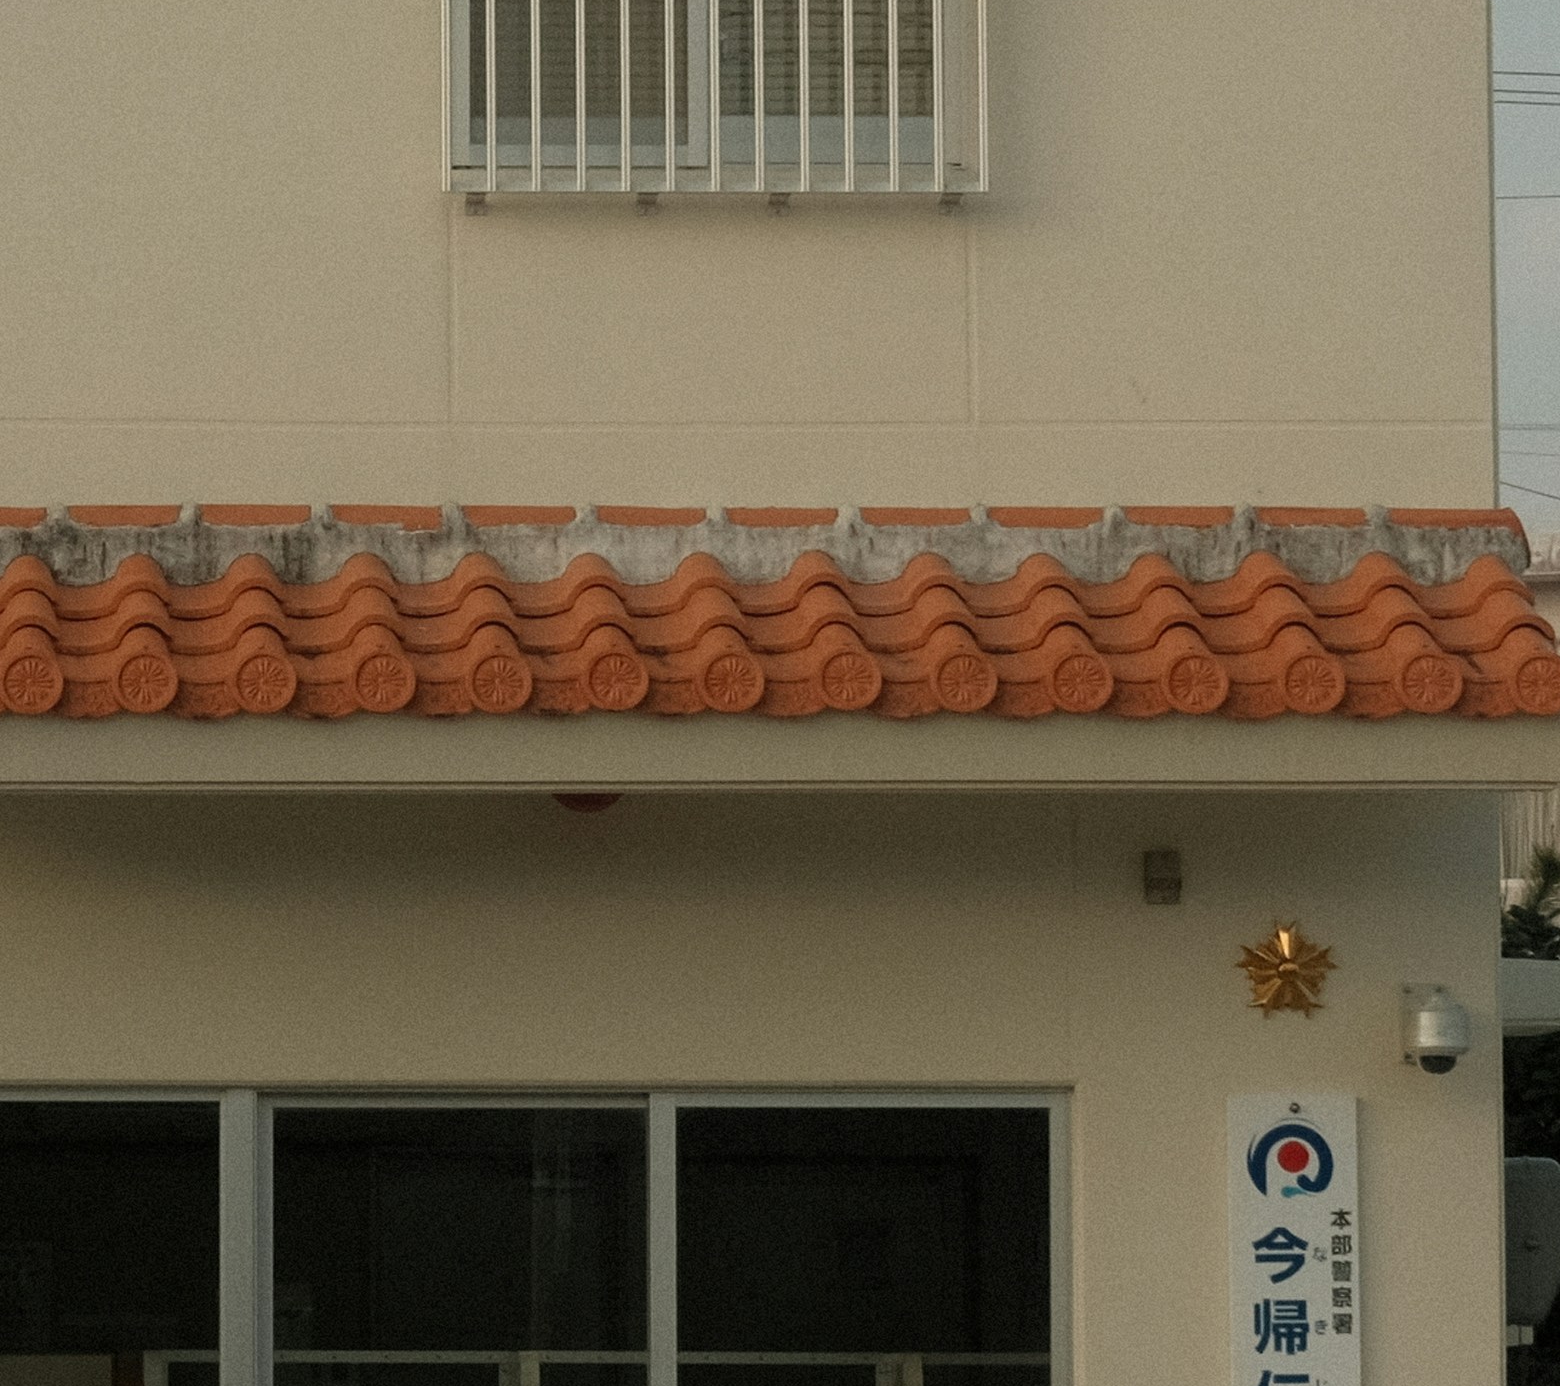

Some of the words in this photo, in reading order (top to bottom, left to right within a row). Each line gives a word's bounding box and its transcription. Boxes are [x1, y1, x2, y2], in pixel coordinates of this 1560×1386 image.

[1330, 1208, 1353, 1335] 本部警察署
